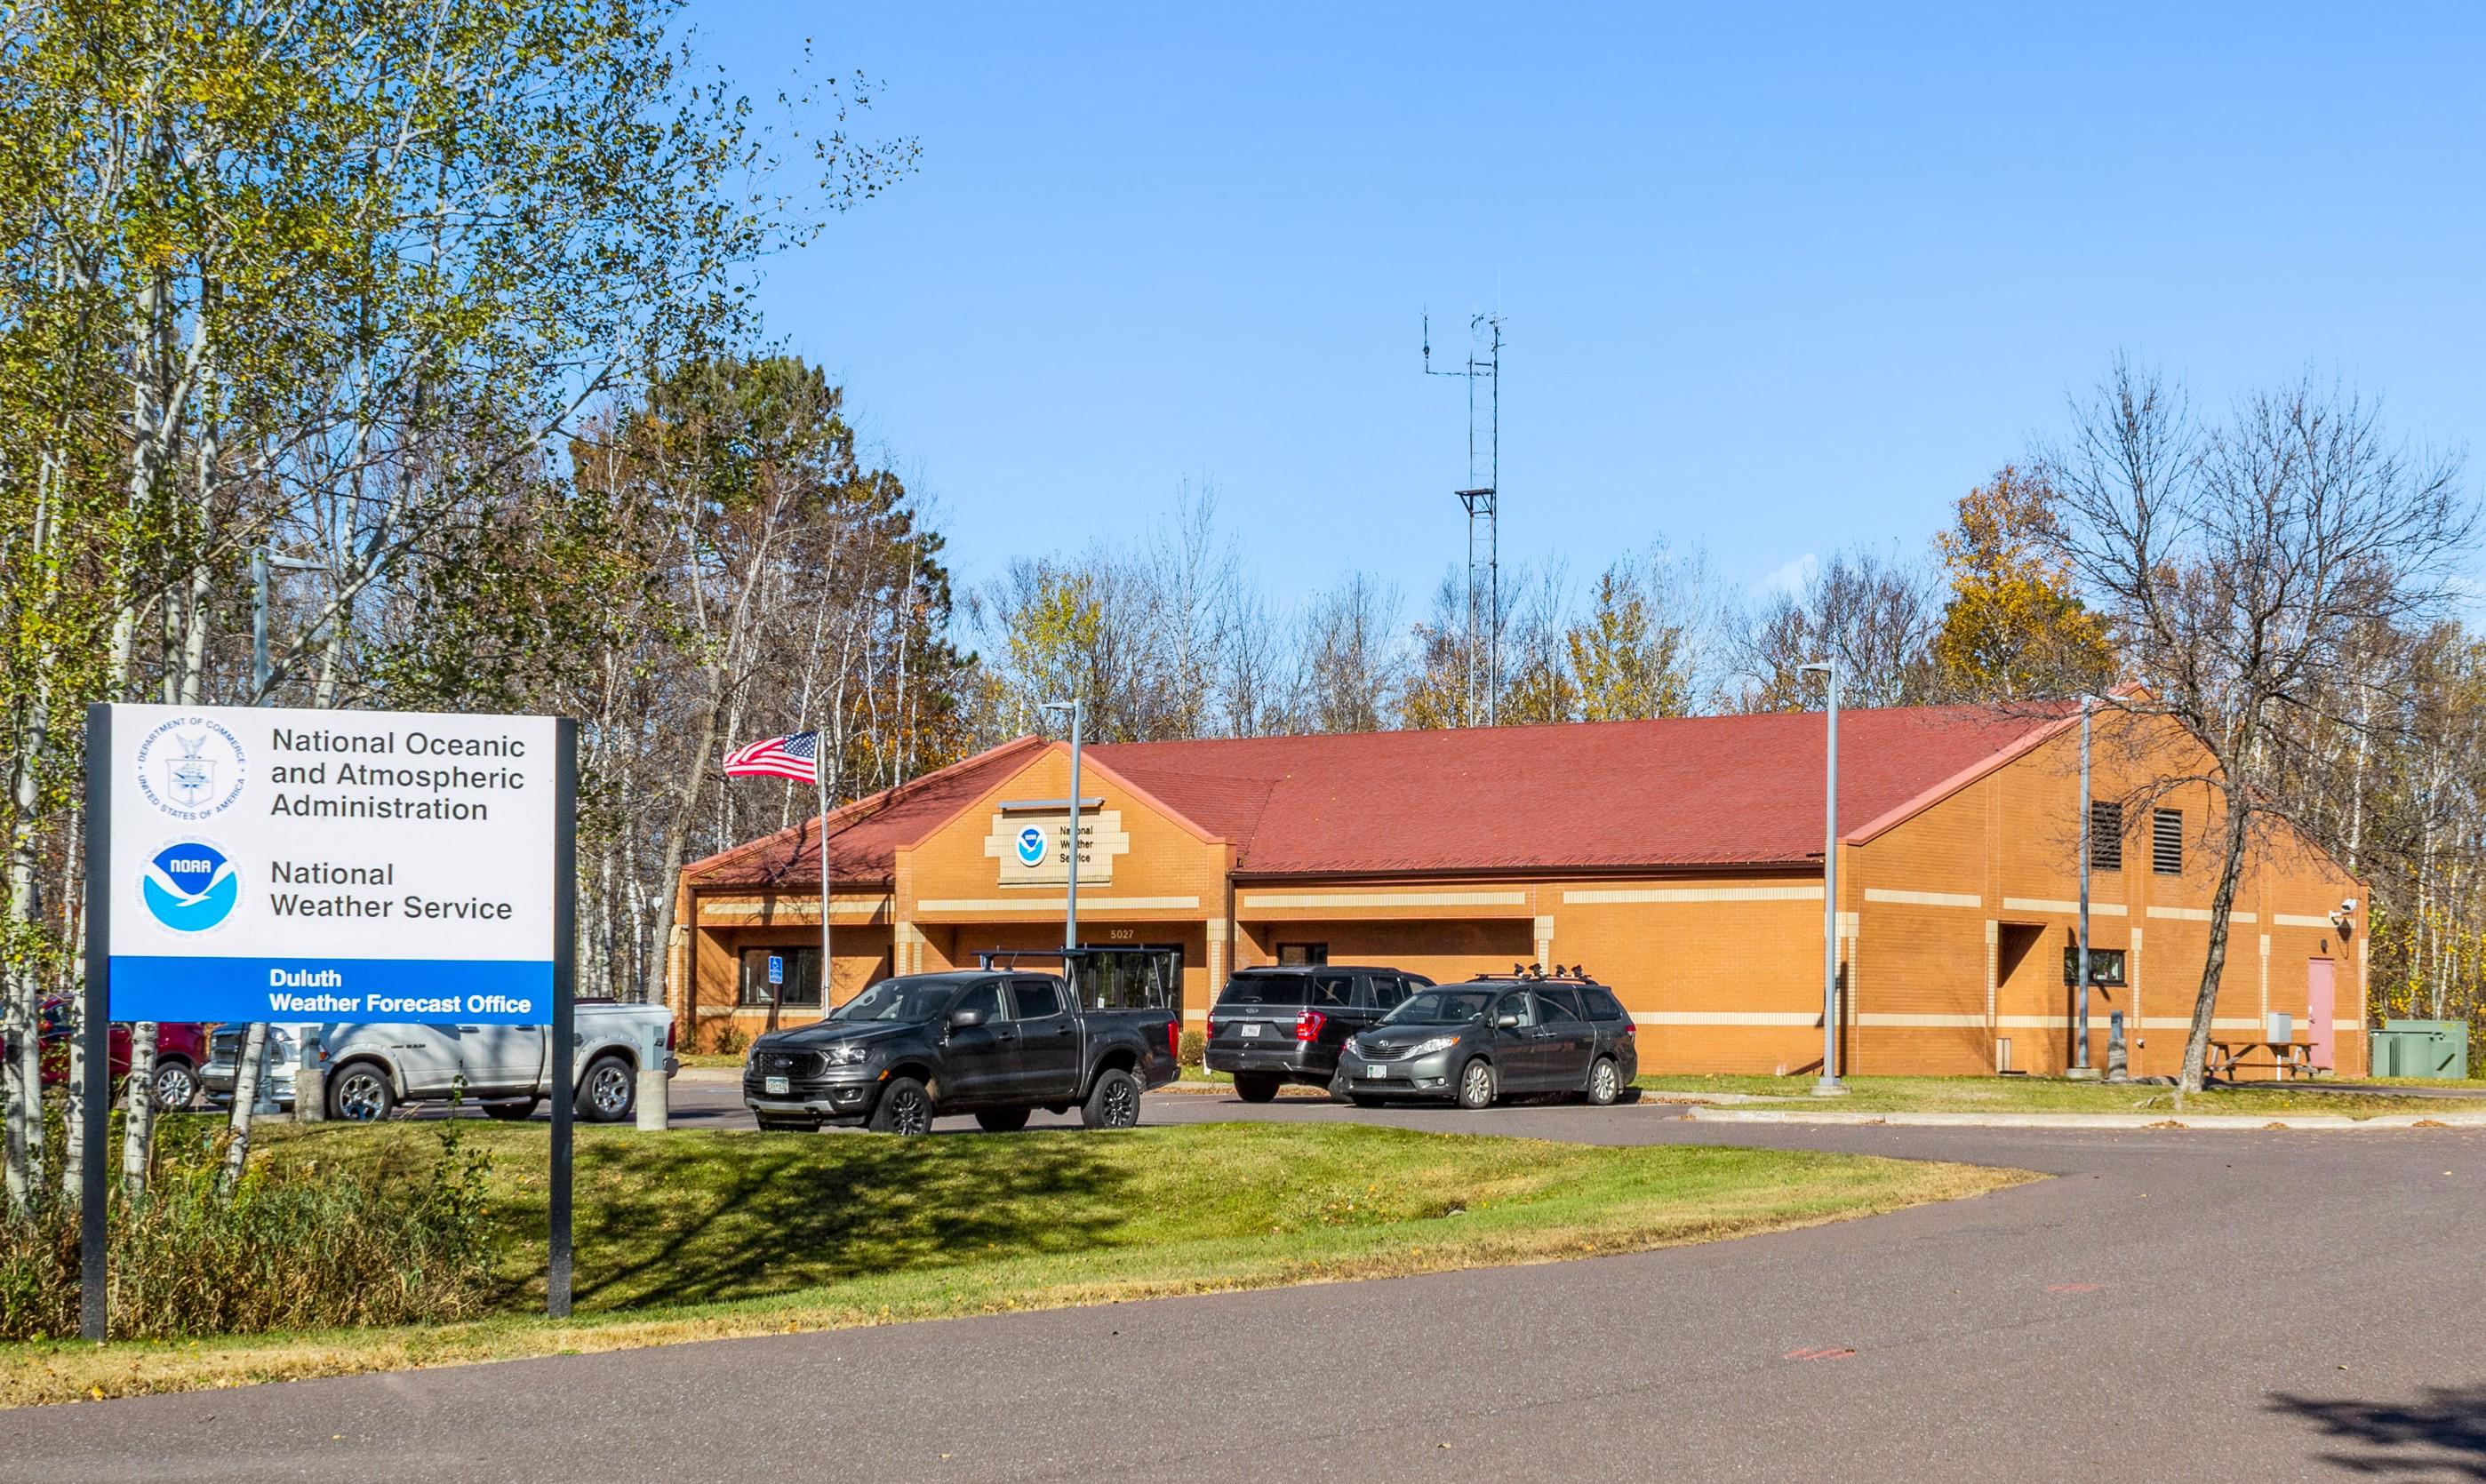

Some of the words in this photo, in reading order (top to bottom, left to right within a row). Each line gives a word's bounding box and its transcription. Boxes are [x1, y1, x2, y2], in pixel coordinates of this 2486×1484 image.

[138, 717, 185, 762] DEPARTMENT
[205, 721, 246, 764] COMMERCE
[273, 729, 394, 754] National
[405, 731, 525, 758] Oceanic
[271, 762, 325, 785] and
[336, 762, 524, 794] Atmospheric
[138, 774, 160, 805] UNITED
[160, 804, 196, 820] STATES
[199, 810, 212, 819] OF
[216, 778, 245, 813] AMERICA
[270, 794, 487, 820] Administration
[1059, 826, 1093, 835] Naonal
[1059, 840, 1093, 850] Wether
[170, 859, 212, 873] NOAA
[1059, 853, 1091, 863] Seice
[272, 861, 393, 886] National
[270, 893, 394, 918] Weather
[404, 896, 512, 920] Service
[1110, 929, 1134, 939] 5027
[269, 969, 342, 987] Duluth
[269, 993, 361, 1012] Weather
[366, 993, 461, 1013] Forecast
[467, 994, 532, 1014] Office
